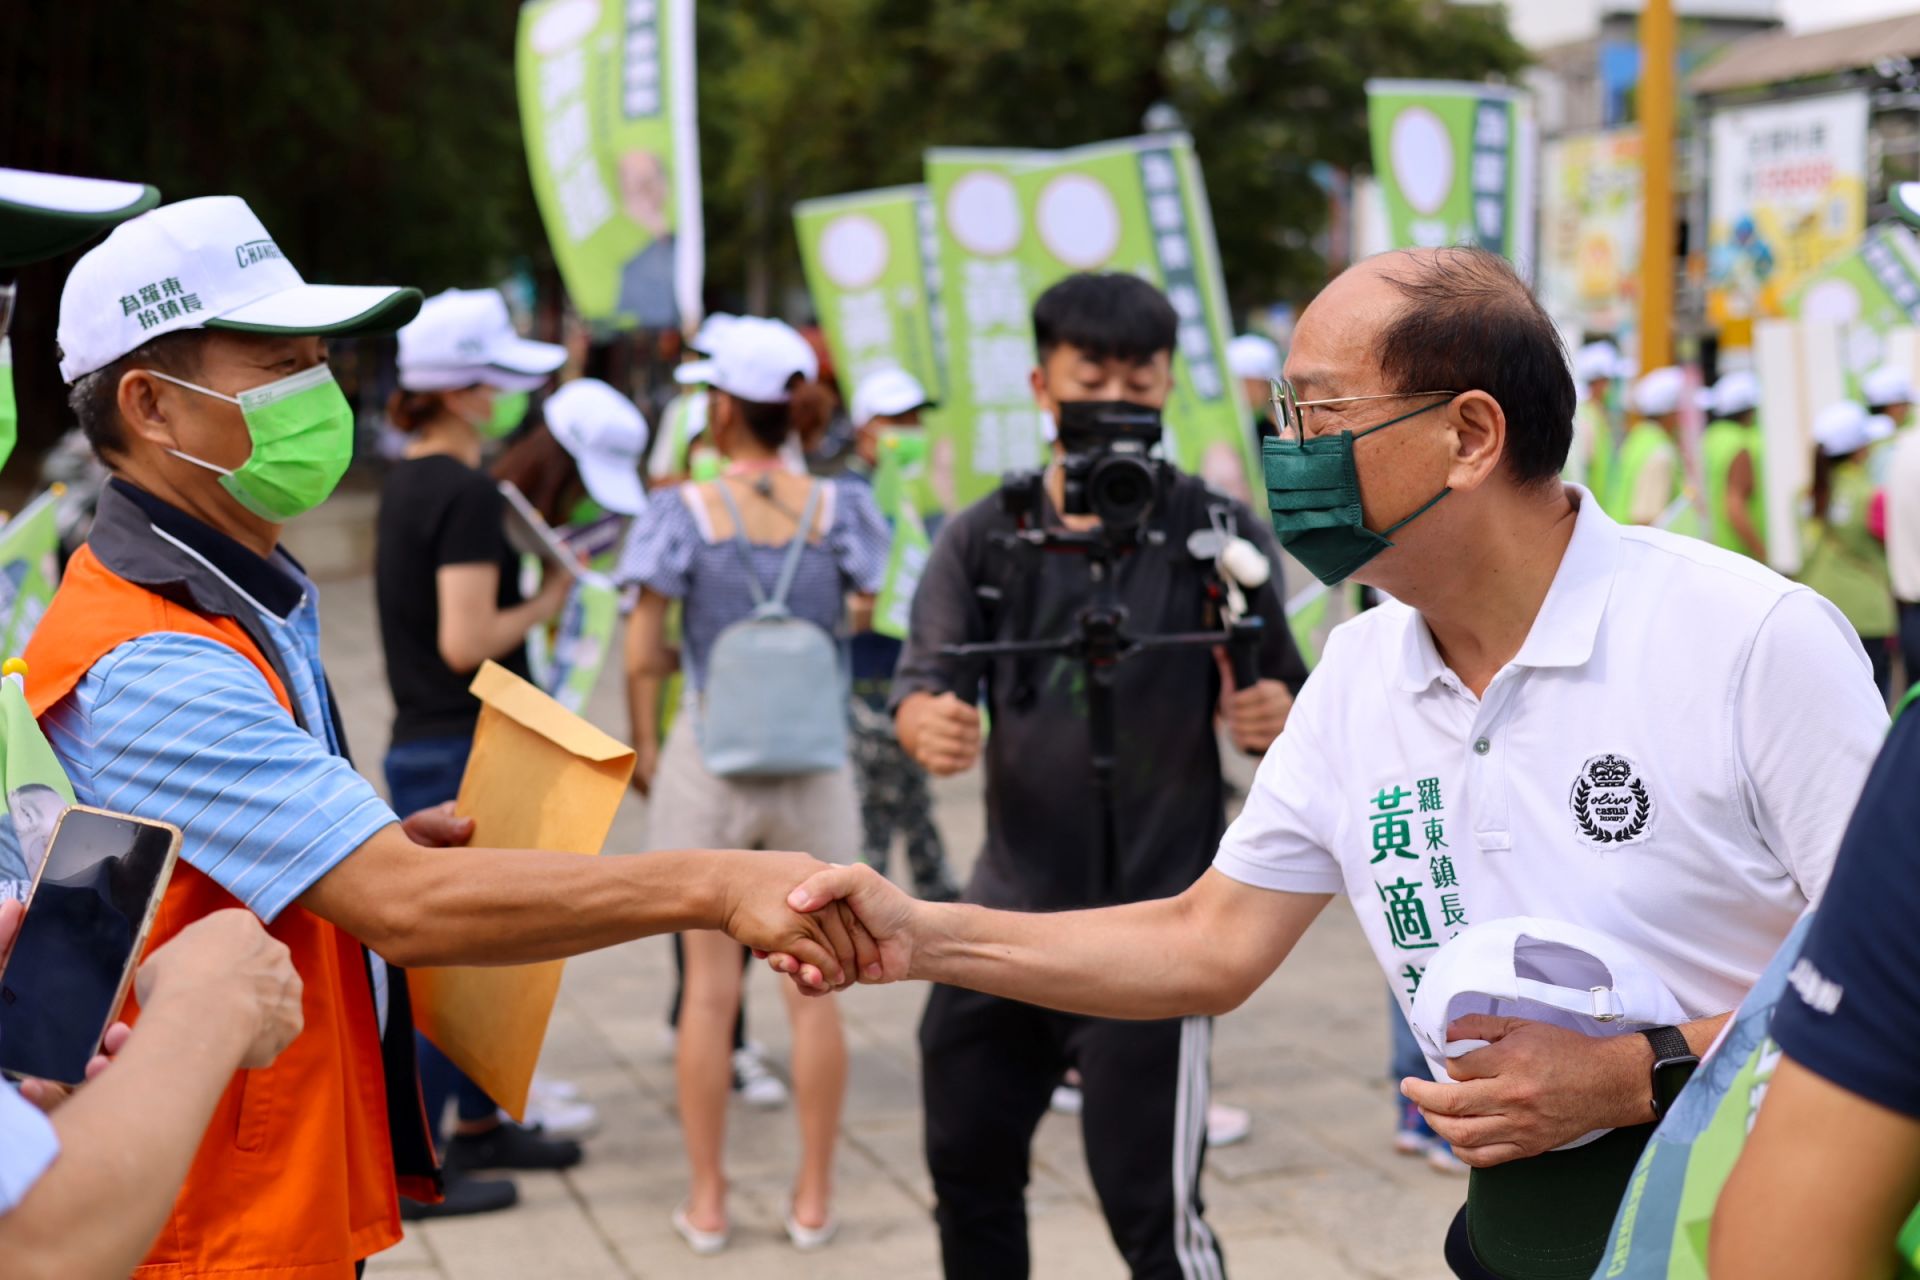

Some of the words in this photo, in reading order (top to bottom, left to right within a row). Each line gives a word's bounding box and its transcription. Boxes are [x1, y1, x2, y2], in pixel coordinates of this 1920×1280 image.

[118, 276, 184, 317] 為羅東
[1595, 806, 1629, 815] casual
[1416, 777, 1469, 941] 羅東鎮長
